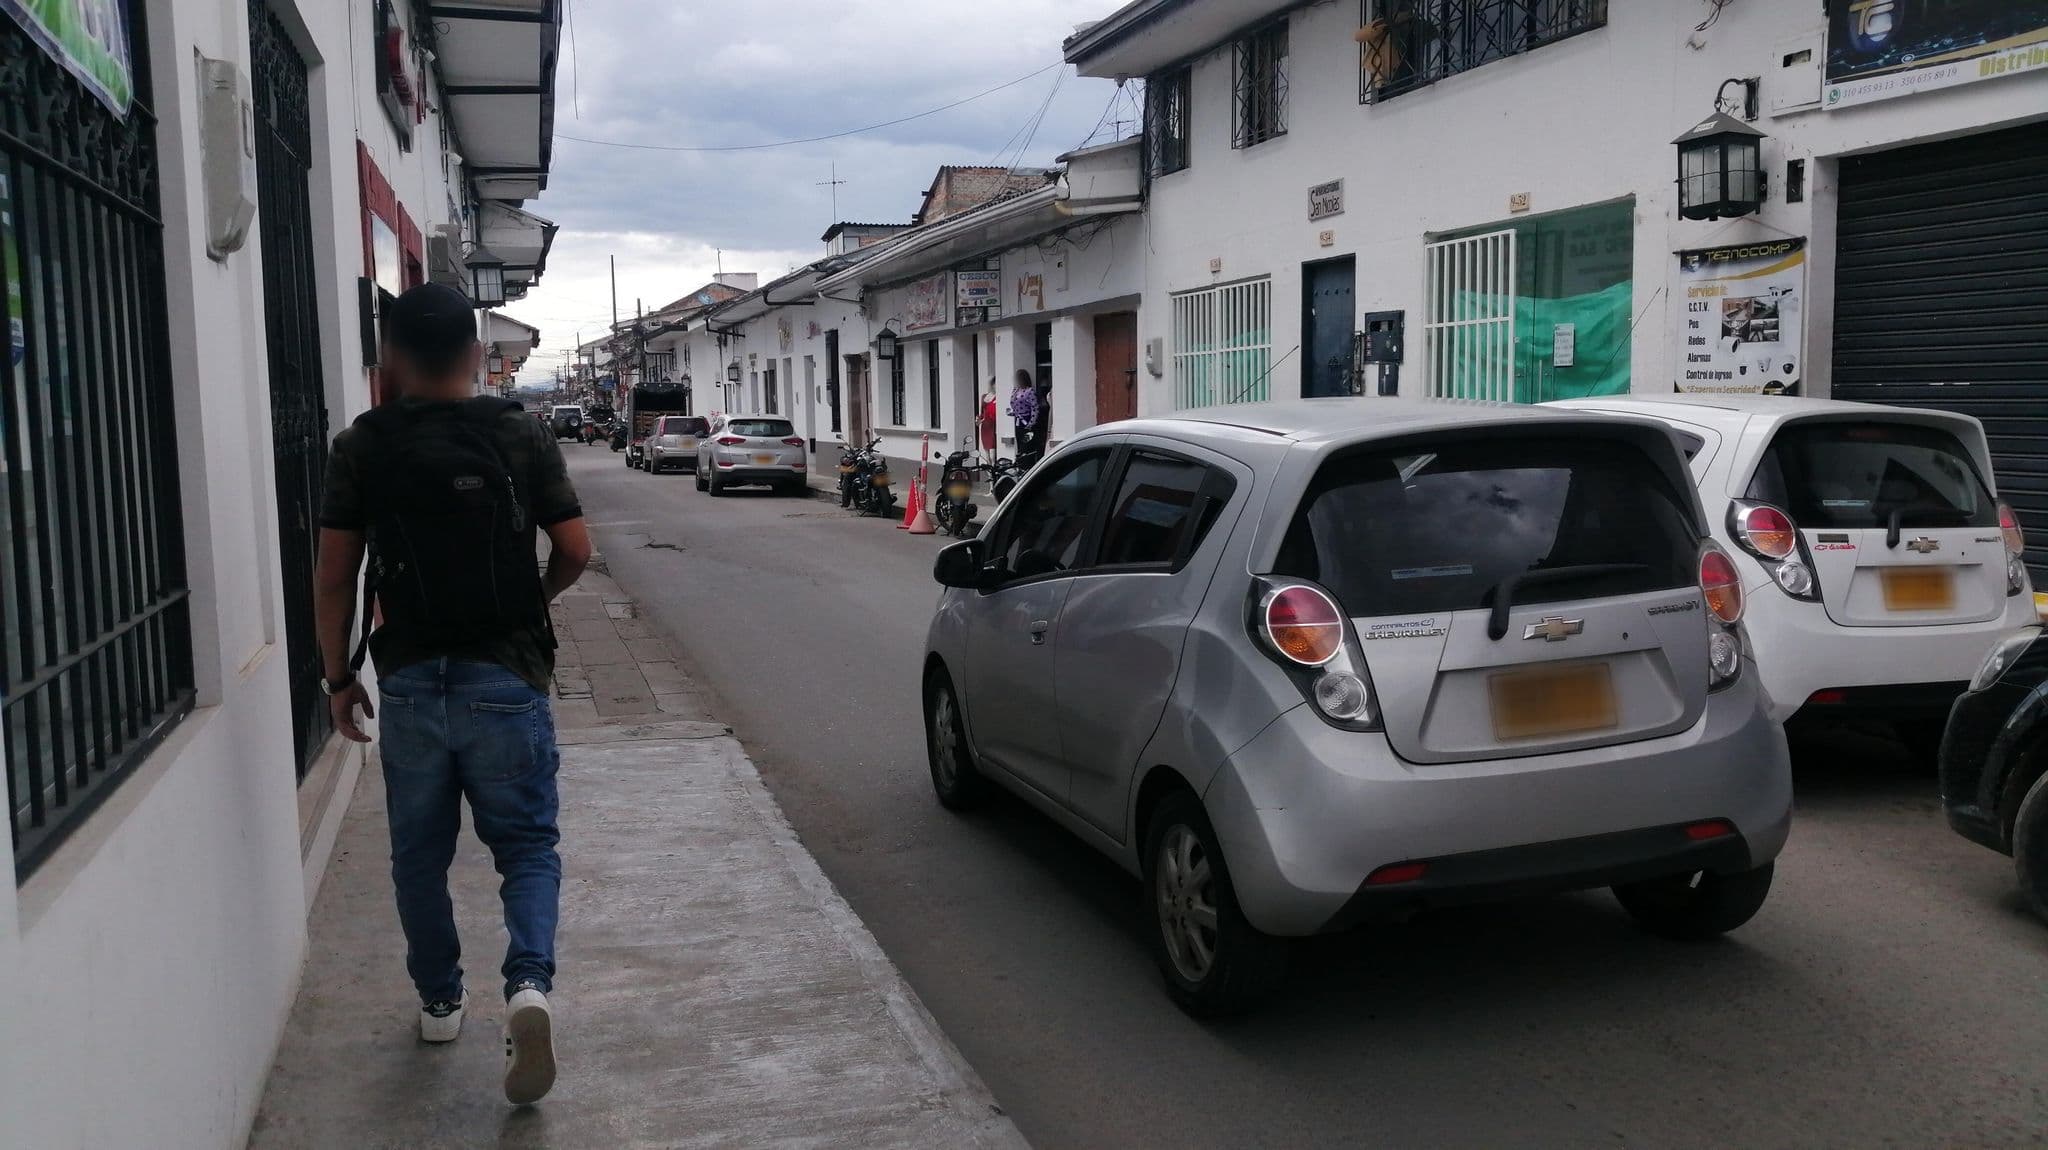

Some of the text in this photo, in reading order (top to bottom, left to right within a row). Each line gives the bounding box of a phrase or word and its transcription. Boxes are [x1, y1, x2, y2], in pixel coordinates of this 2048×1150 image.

[1979, 48, 2048, 78] Distrib
[1688, 335, 1706, 346] Redes
[1687, 353, 1711, 363] Alarmas
[1686, 369, 1708, 380] Control
[1365, 628, 1447, 640] CHEVROLET
